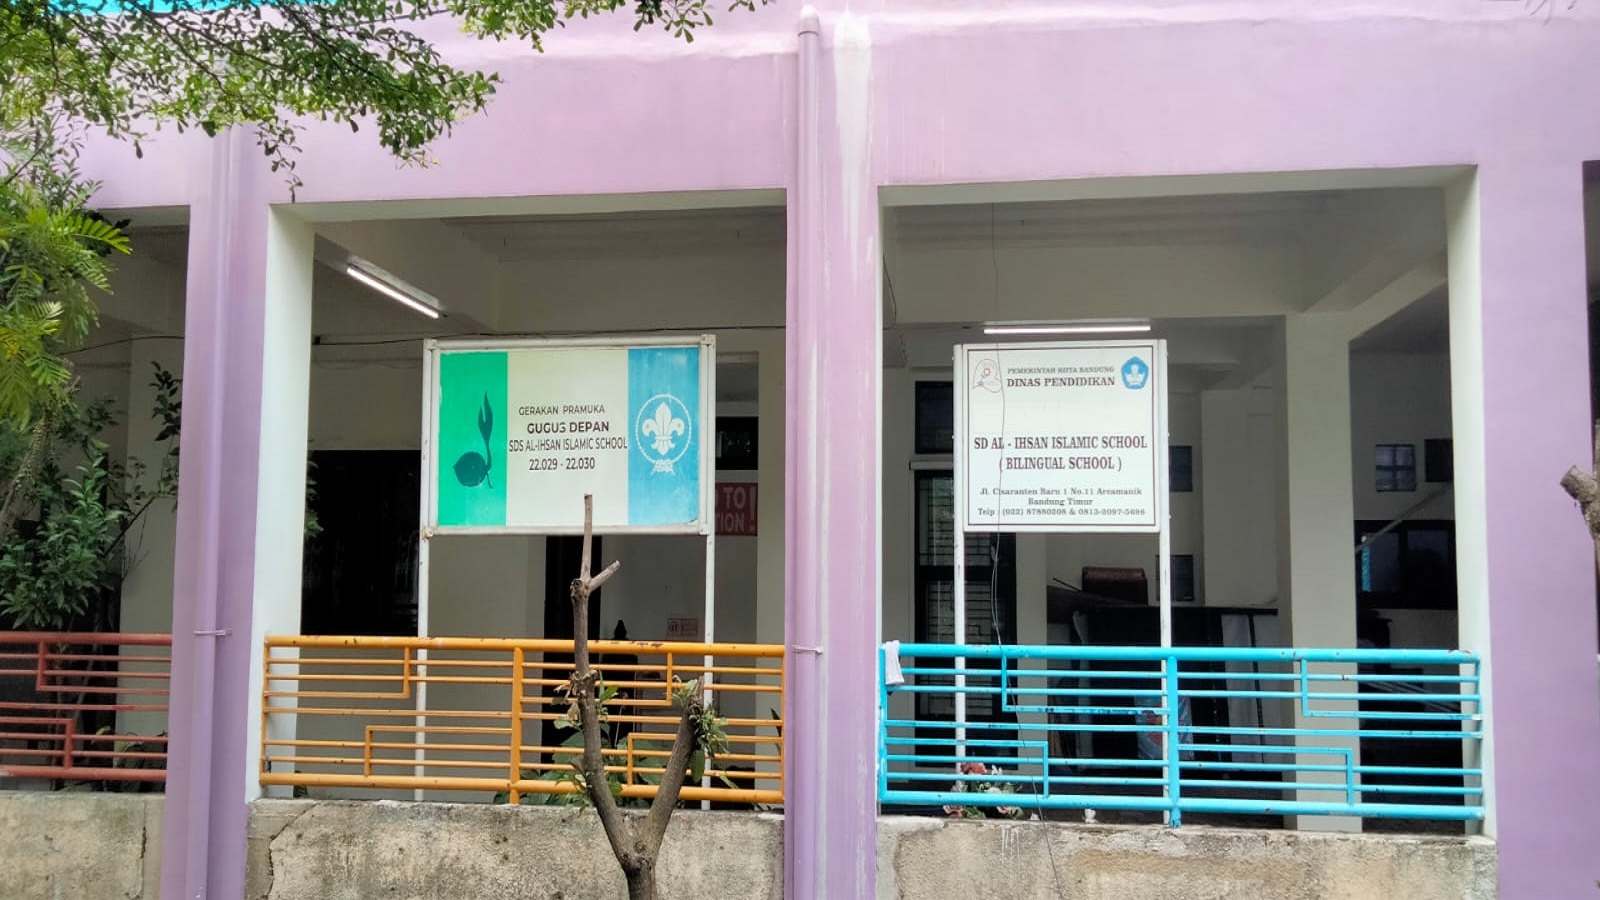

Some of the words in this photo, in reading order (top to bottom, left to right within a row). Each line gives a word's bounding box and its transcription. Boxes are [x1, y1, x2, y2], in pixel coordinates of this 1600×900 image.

[1058, 366, 1077, 374] KOTA
[1079, 365, 1115, 373] BANDUNG
[1007, 378, 1040, 387] DINAS
[1044, 376, 1115, 387] PENDIDIKAN
[519, 406, 558, 416] GERAKAN
[563, 404, 605, 414] PRAMUKA
[527, 422, 566, 434] GUGUS
[569, 421, 609, 432] DEPAN
[509, 440, 524, 452] SDS
[526, 439, 561, 451] AL-IHSAN
[563, 438, 594, 450] ISLAMIC
[595, 437, 628, 449] SCHOOL
[974, 437, 989, 450] SD
[991, 437, 1005, 450] AL
[1014, 437, 1048, 449] IHSAN
[1052, 436, 1098, 449] ISLAMIC
[1101, 435, 1147, 448] SCHOOL
[529, 458, 558, 471] 22.029
[566, 457, 595, 470] 22.030
[1006, 456, 1065, 470] BILINGUAL
[1068, 456, 1115, 469] SCHOOL
[723, 487, 746, 509] TO
[1028, 498, 1065, 506] Bandung
[977, 508, 995, 516] Telp
